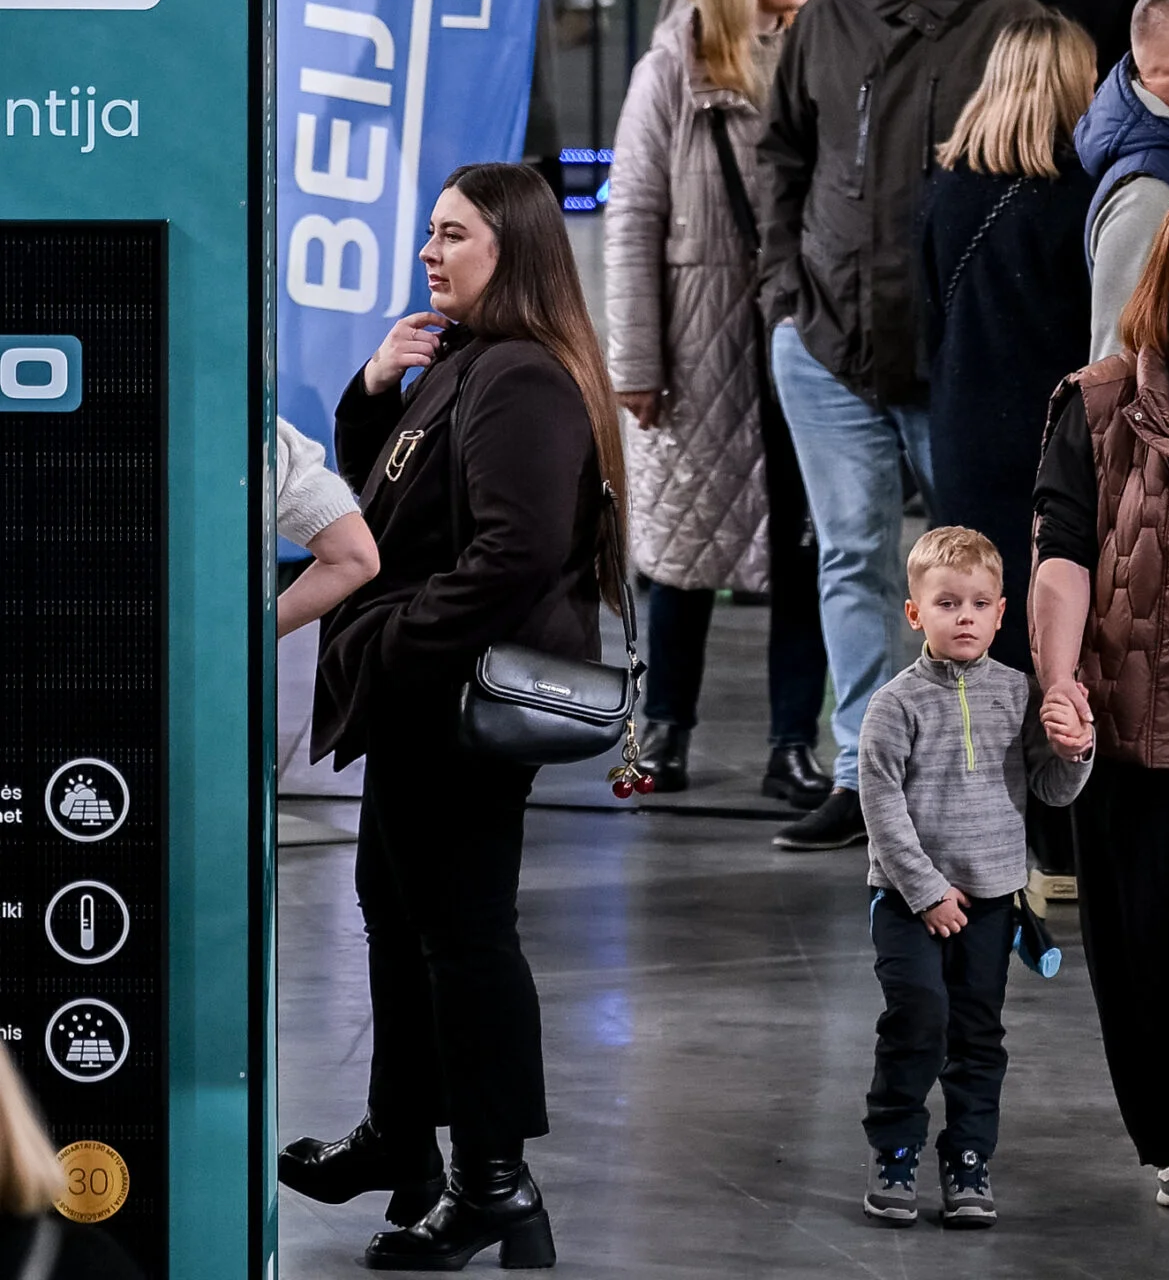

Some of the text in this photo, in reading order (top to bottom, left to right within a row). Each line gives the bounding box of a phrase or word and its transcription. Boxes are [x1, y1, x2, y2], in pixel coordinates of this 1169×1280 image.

[7, 86, 140, 153] ntija
[1, 784, 22, 801] ės
[2, 902, 22, 919] iki
[68, 1167, 108, 1196] 30
